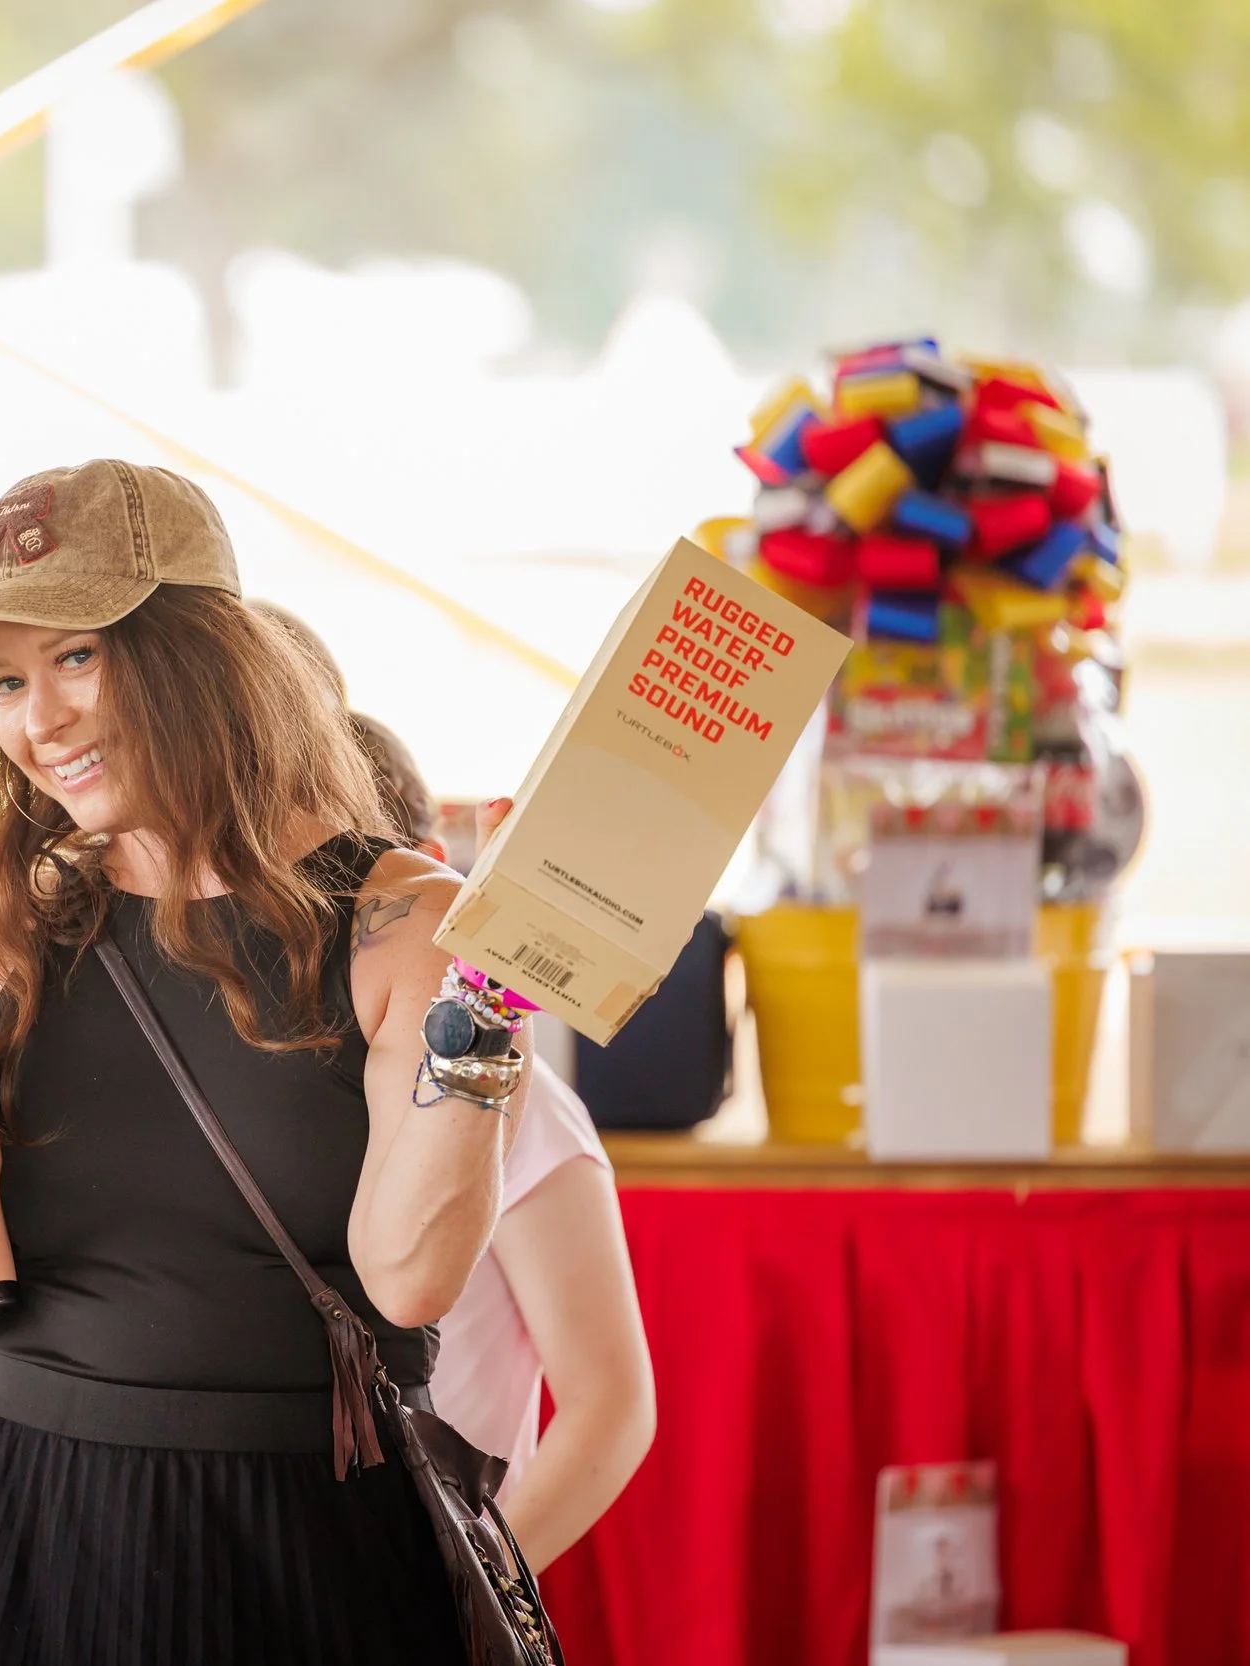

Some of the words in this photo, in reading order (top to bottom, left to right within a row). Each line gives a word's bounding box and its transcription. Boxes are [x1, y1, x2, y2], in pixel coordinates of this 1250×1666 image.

[672, 599, 775, 673] WATER-
[683, 576, 796, 657] RUGGED
[655, 624, 751, 689] PROOF
[627, 672, 726, 744] SOUND
[641, 648, 774, 742] PREMIUM
[616, 708, 692, 762] TURTLEBOX
[542, 858, 644, 926] TURTLEBOXAUDIO.COM
